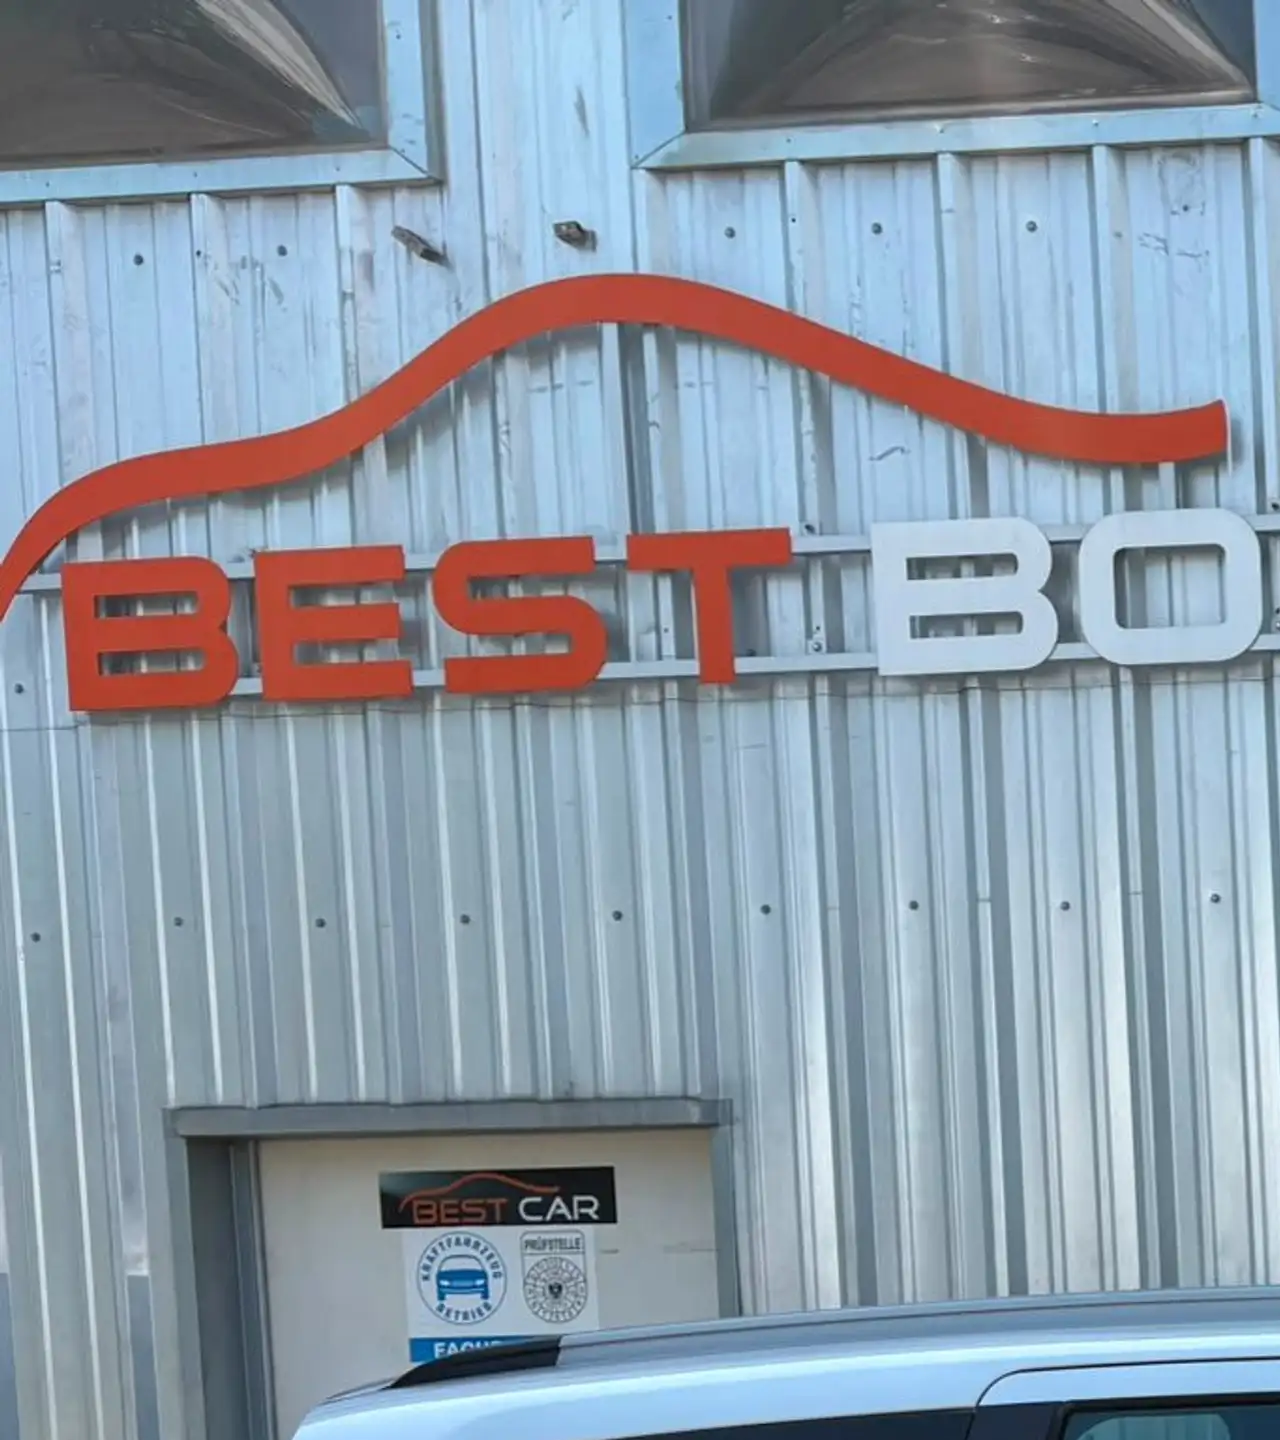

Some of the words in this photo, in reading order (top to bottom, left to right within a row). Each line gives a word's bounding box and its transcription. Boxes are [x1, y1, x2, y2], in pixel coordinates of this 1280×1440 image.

[61, 528, 791, 711] BEST
[412, 1198, 508, 1225] BEST
[518, 1195, 600, 1222] CAR
[524, 1236, 581, 1250] PRÜFSTELLE
